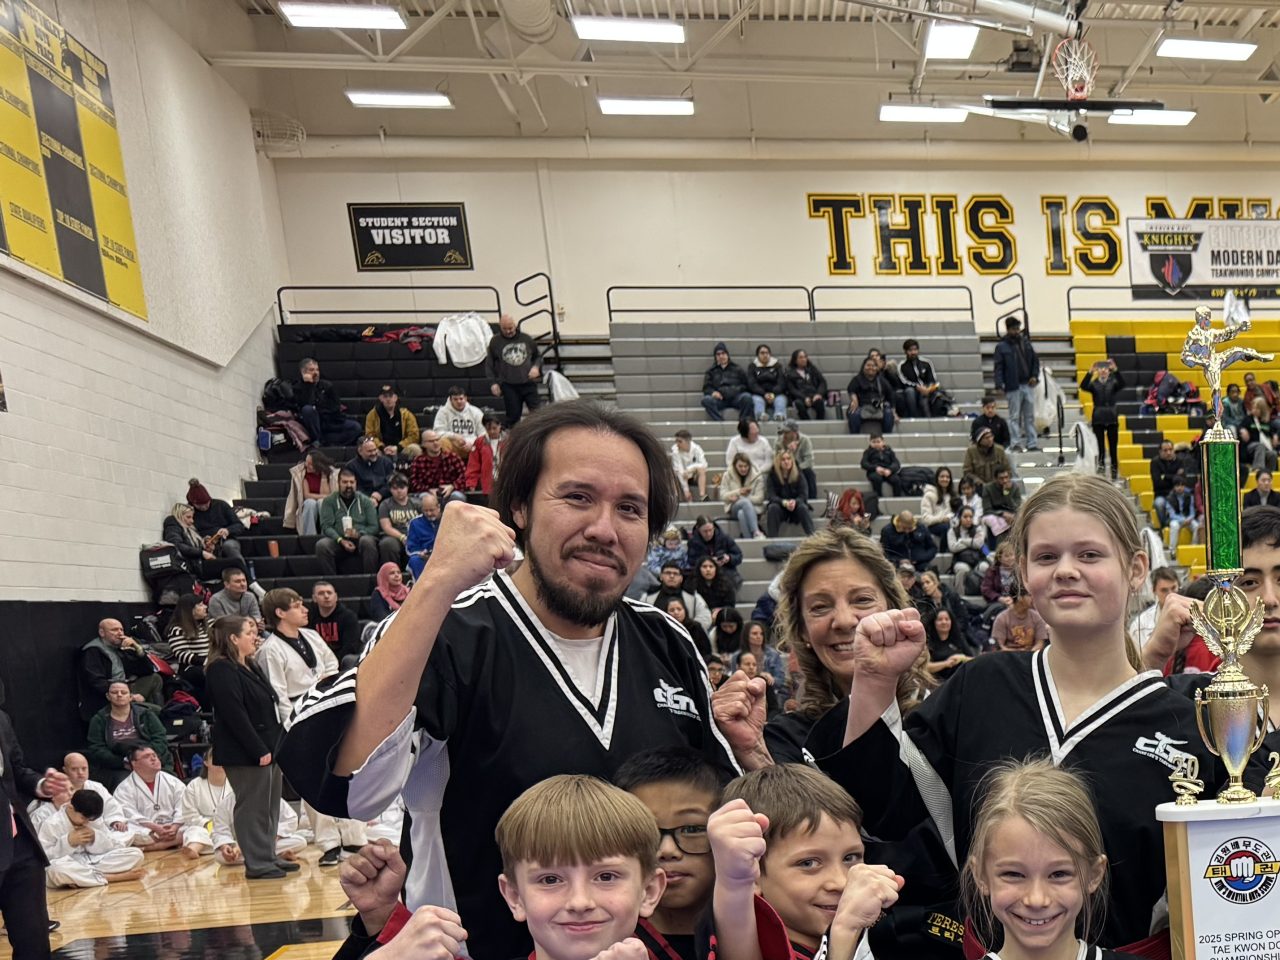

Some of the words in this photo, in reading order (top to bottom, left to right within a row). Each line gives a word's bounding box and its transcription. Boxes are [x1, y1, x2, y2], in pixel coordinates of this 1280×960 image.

[359, 217, 409, 227] STUDENT
[411, 216, 458, 227] SECTION
[370, 228, 451, 245] VISITOR
[806, 192, 1018, 275] THIS
[1040, 195, 1122, 276] IS
[1143, 233, 1196, 246] KNIGHTS
[1207, 224, 1250, 249] ELITE
[1210, 250, 1263, 266] MODERN
[1211, 867, 1227, 876] 태
[1259, 863, 1274, 873] 권
[927, 912, 965, 936] TERES
[1199, 934, 1222, 944] 2025
[1224, 930, 1264, 942] SPRING
[1211, 945, 1231, 955] TAE
[1234, 942, 1266, 953] KWON
